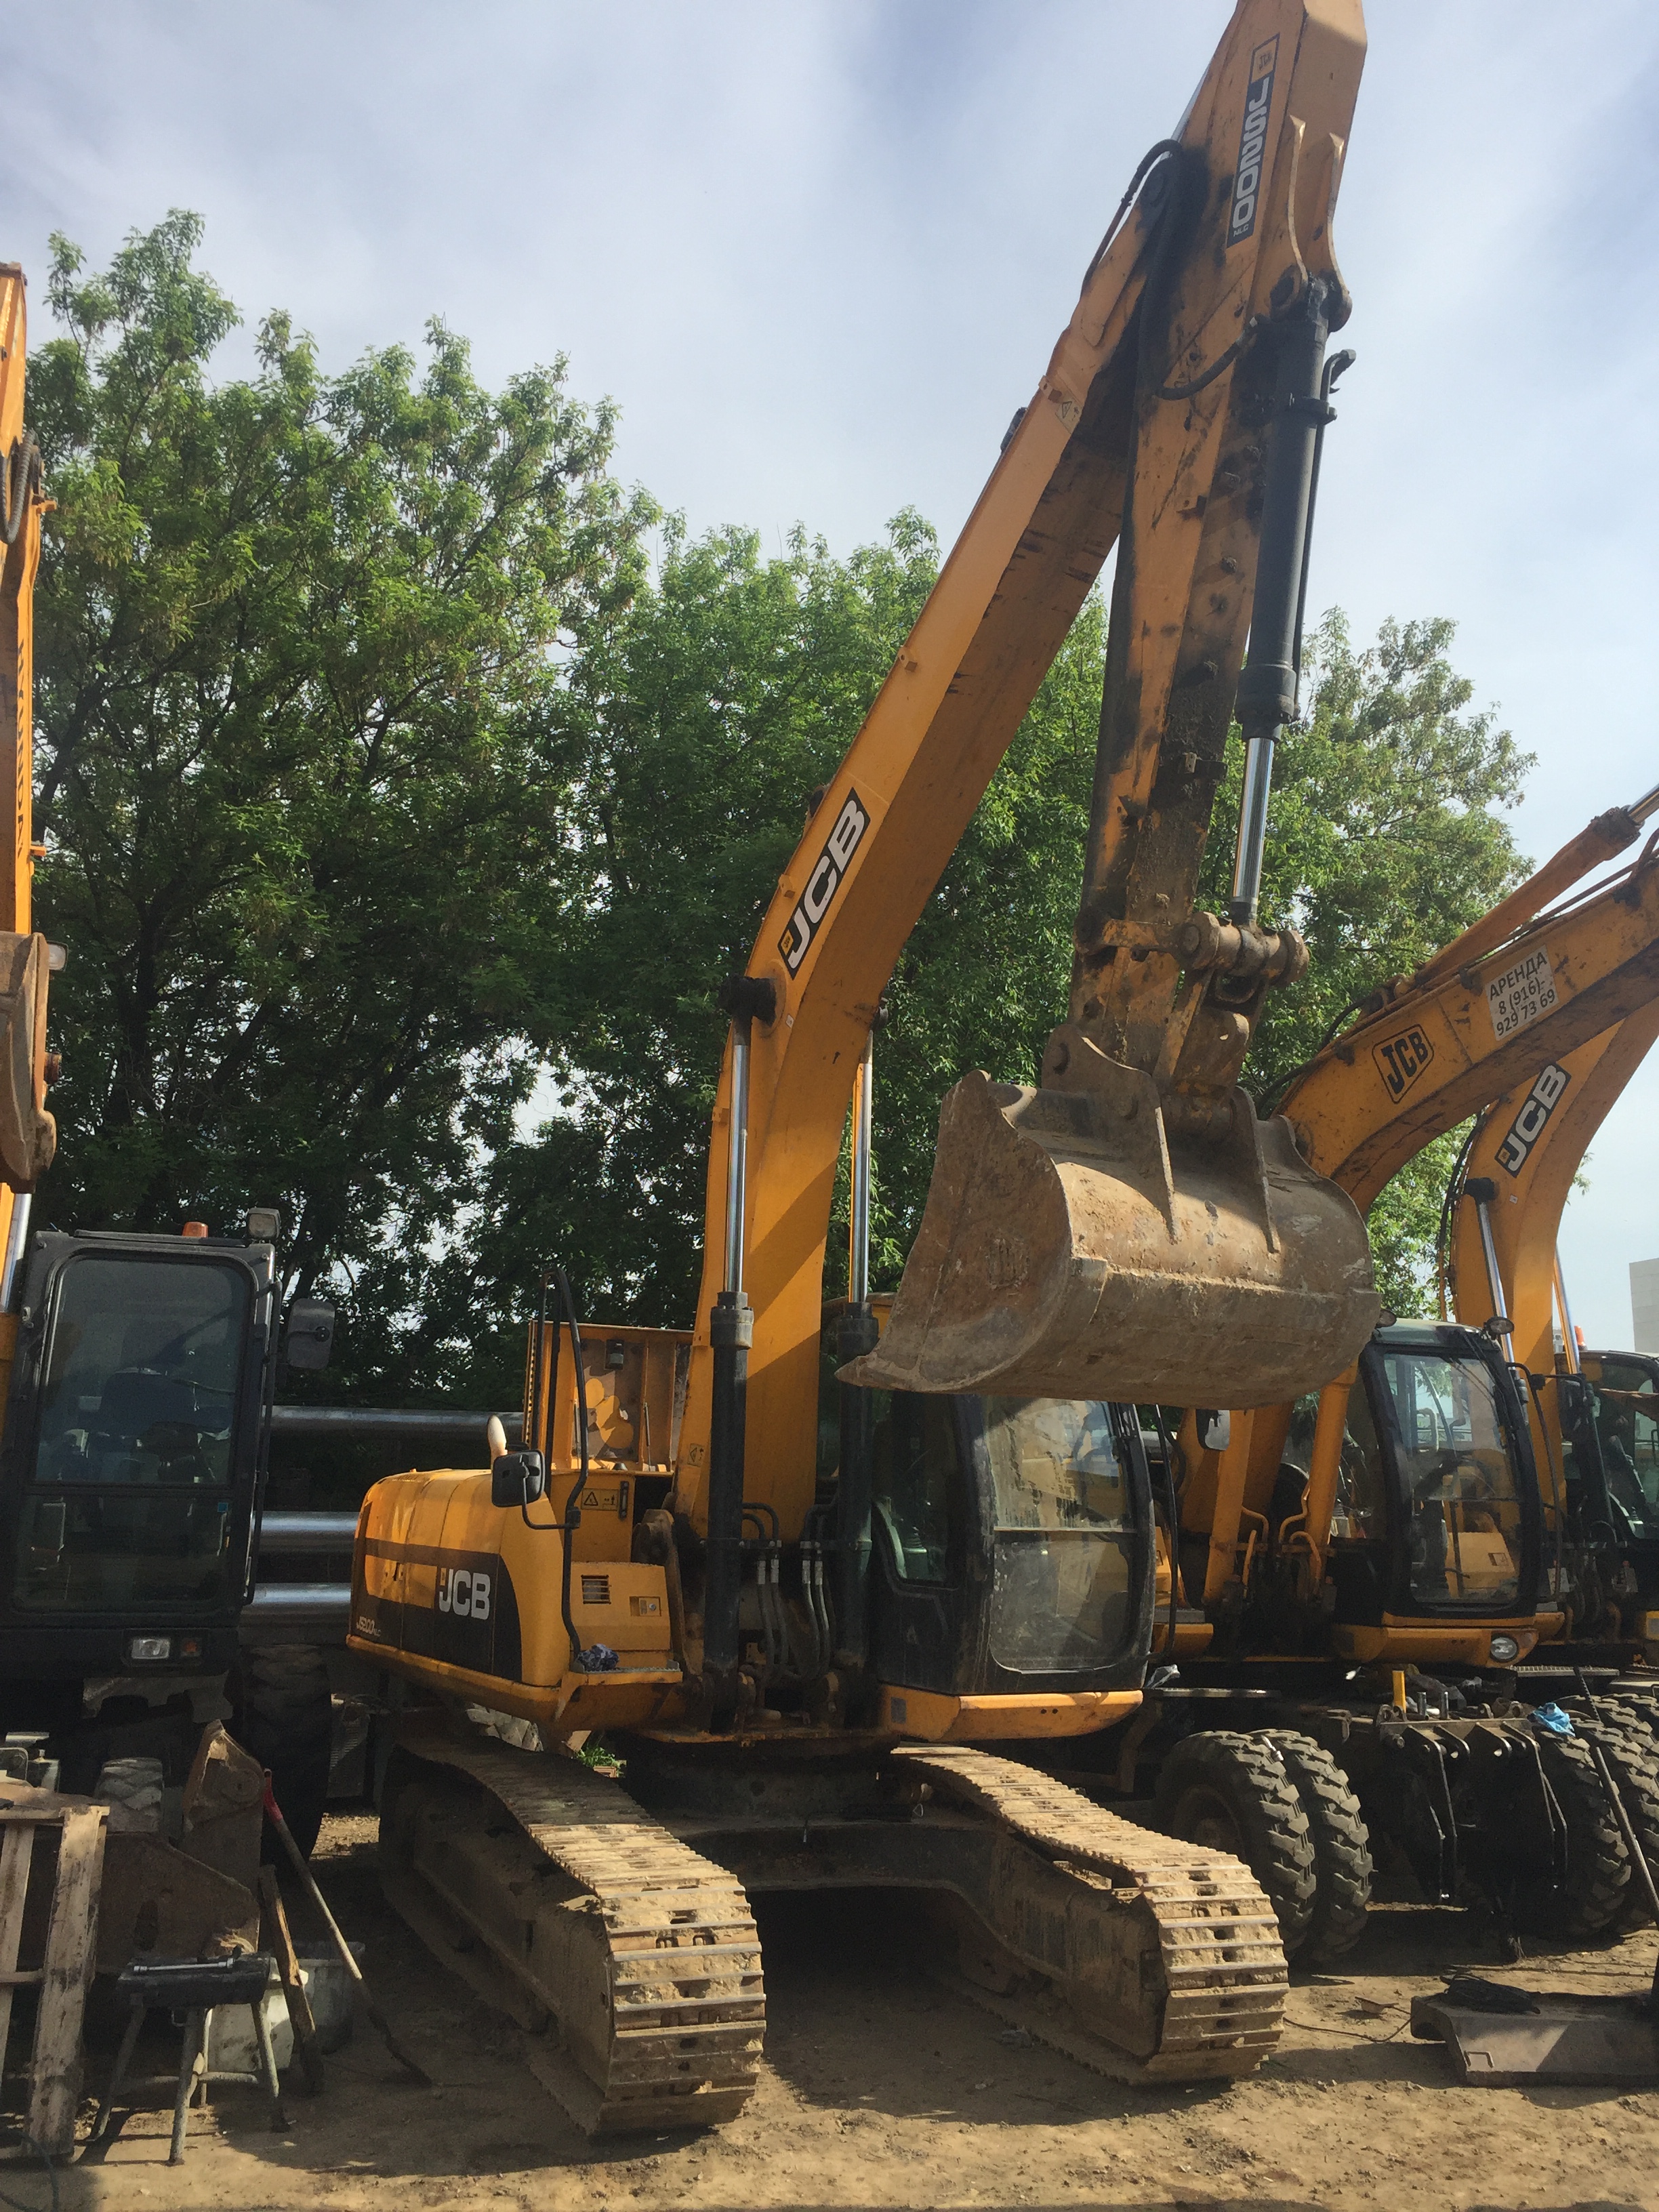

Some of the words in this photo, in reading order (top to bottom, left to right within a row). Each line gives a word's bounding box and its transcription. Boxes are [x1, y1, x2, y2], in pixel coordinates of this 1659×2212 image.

[1233, 77, 1270, 228] JS200
[787, 800, 865, 969] JCB
[1490, 951, 1548, 1002] АРЕНДА
[1496, 1012, 1519, 1036] 929
[1521, 1000, 1537, 1020] 73
[1540, 989, 1555, 1008] 69
[1498, 1000, 1507, 1015] 8
[1380, 1033, 1429, 1095] JCB
[1507, 1064, 1568, 1172] JCB
[439, 1568, 491, 1620] JCB
